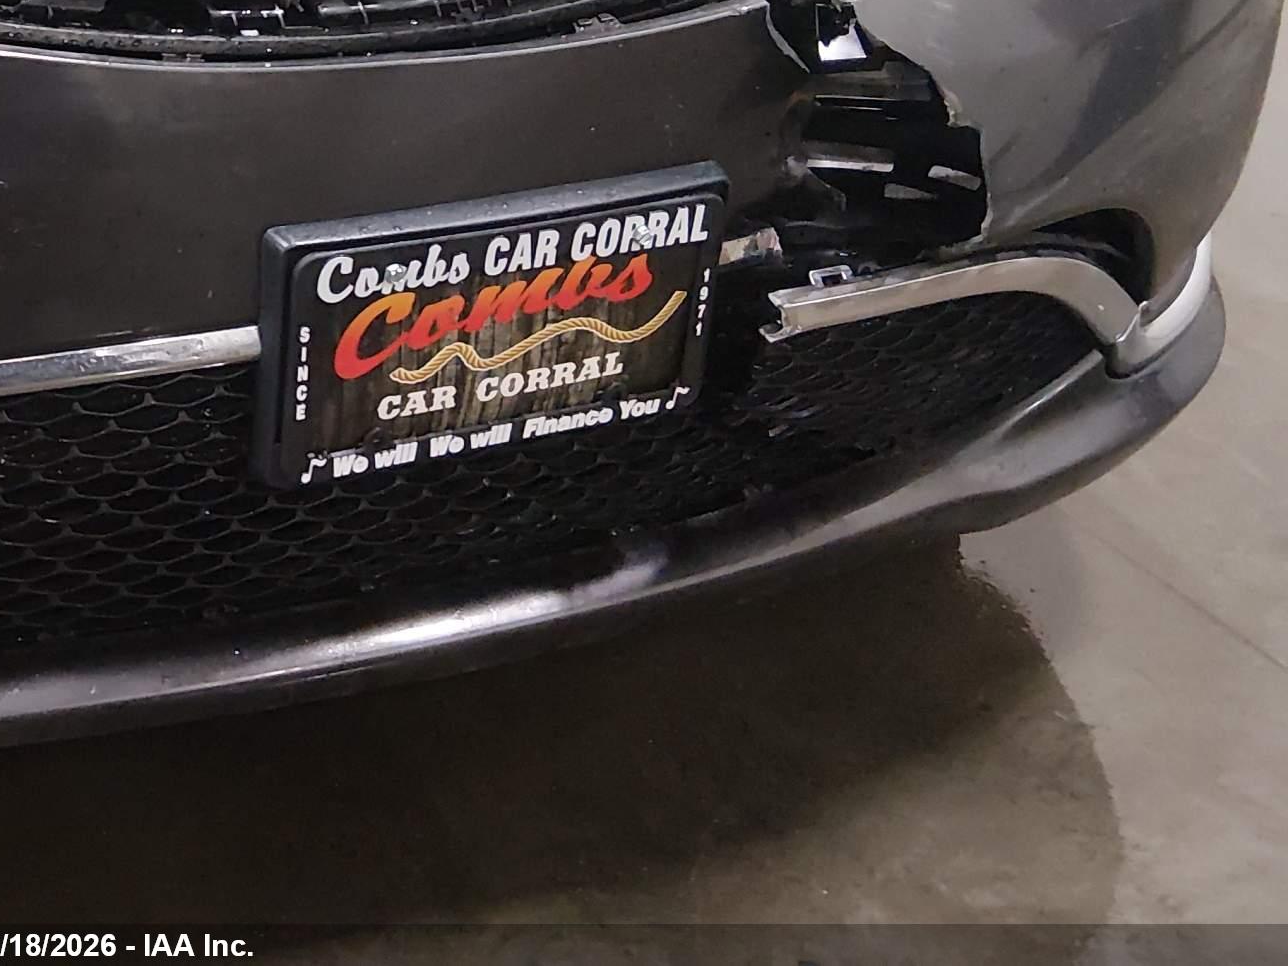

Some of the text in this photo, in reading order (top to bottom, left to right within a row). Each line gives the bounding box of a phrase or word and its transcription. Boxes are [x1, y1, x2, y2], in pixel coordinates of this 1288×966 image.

[317, 204, 709, 304] Combs CAR CORRAL
[334, 253, 653, 380] Combs
[695, 267, 711, 337] 1971
[295, 325, 311, 421] SINCE
[377, 351, 624, 420] CAR CORRAL
[333, 398, 661, 478] We will We will Finance You
